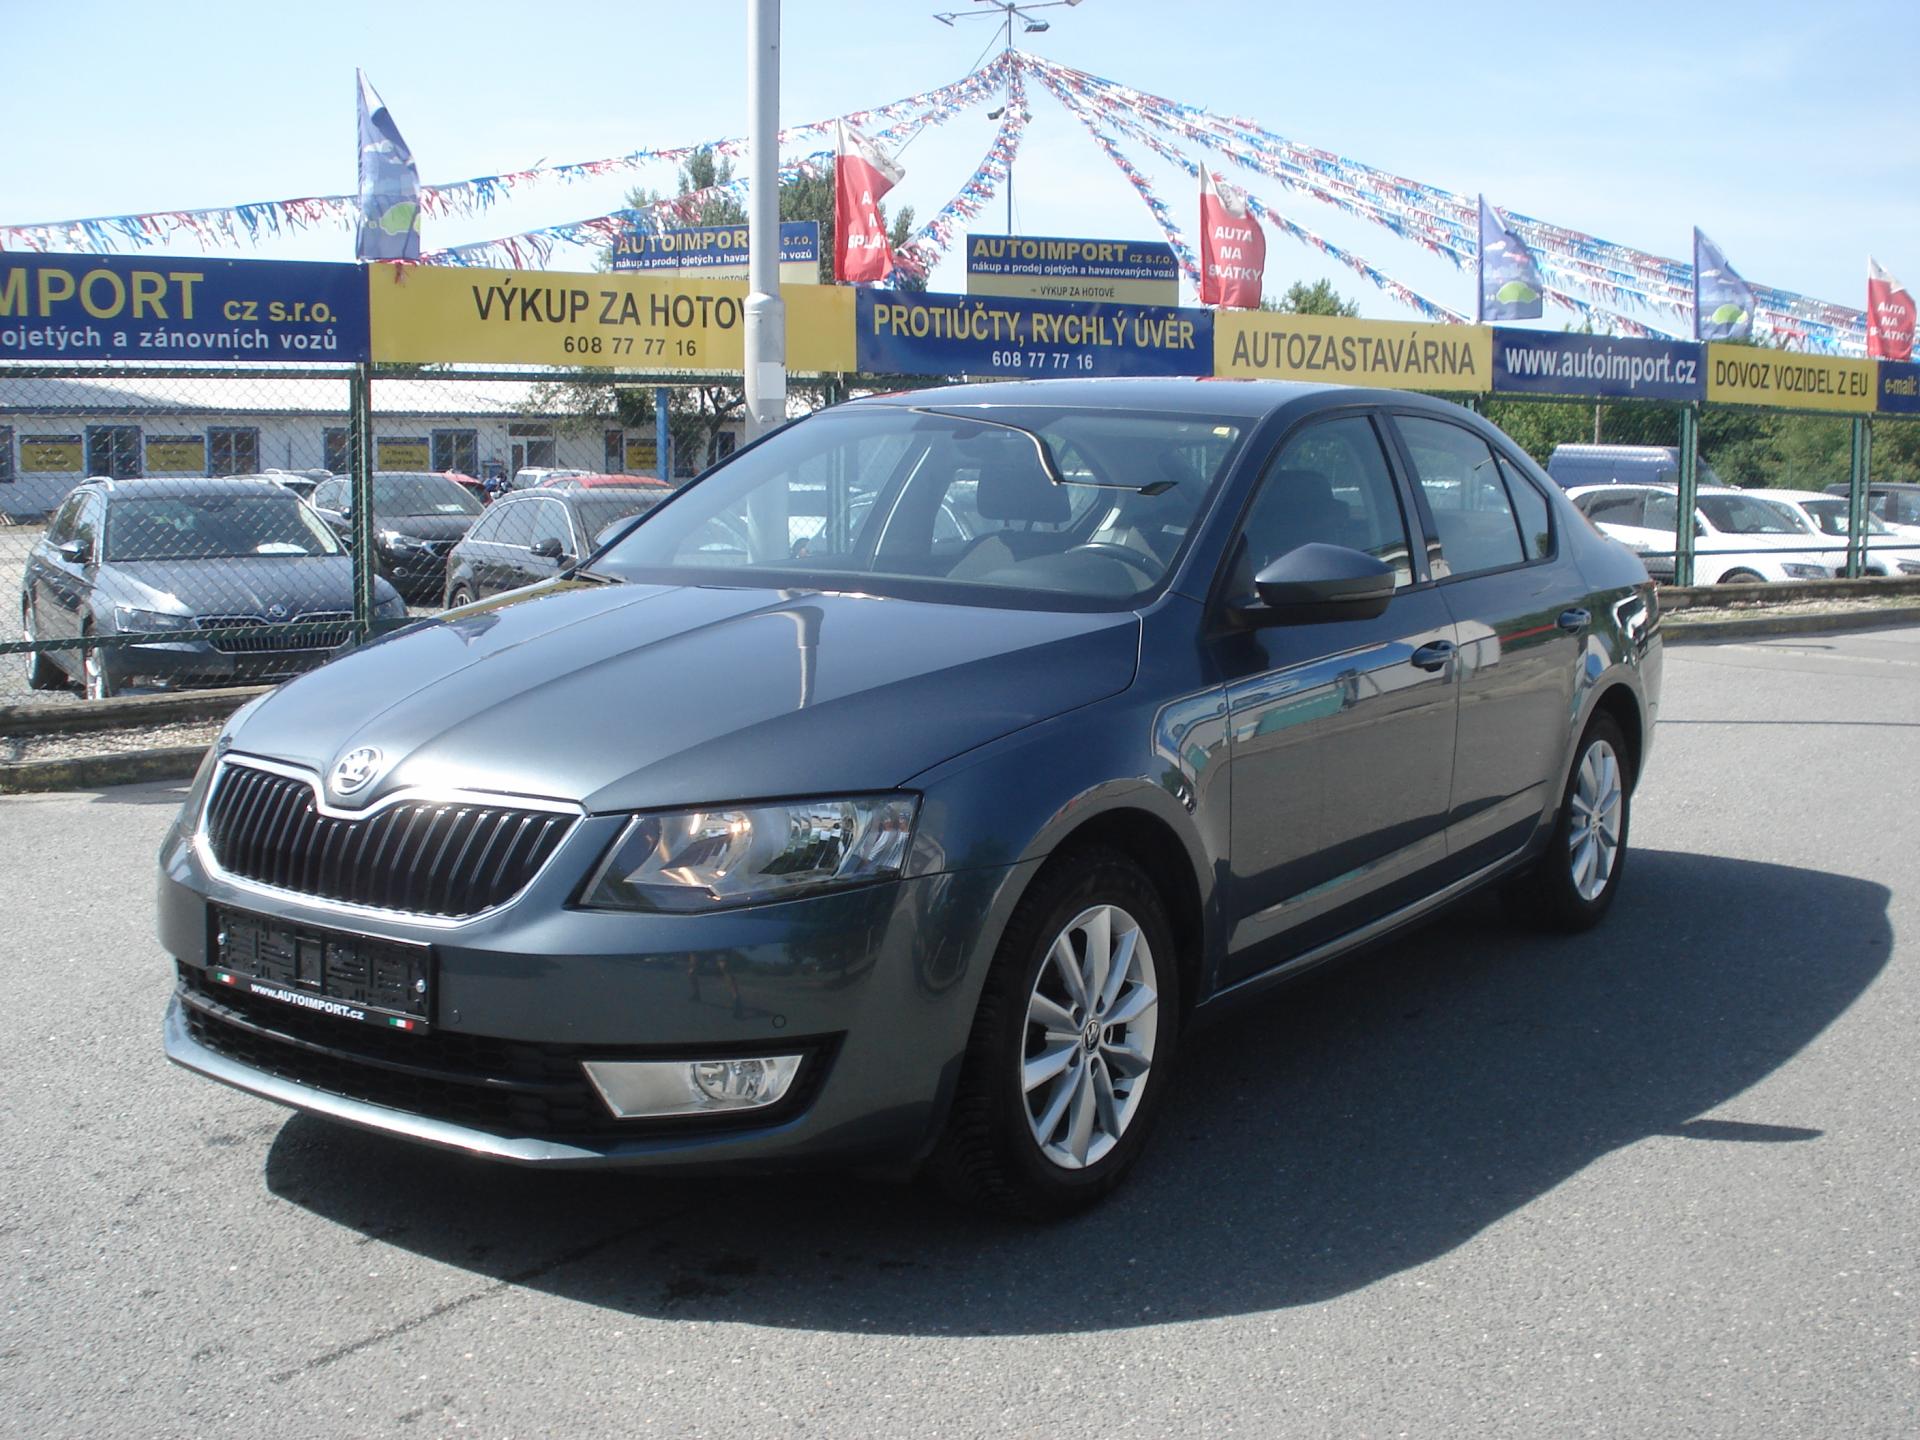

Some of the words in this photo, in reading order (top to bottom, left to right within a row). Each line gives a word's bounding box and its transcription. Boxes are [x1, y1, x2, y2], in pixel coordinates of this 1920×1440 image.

[617, 230, 750, 255] AUTOIMPOR
[1215, 226, 1253, 242] AUTA
[616, 256, 643, 268] nákup
[652, 256, 679, 267] prodej
[681, 254, 713, 266] ojetých
[715, 255, 721, 263] a
[973, 239, 1128, 263] AUTOIMPORT
[1220, 246, 1242, 260] NA
[972, 261, 1002, 273] nákup
[1003, 263, 1010, 271] a
[1012, 263, 1042, 275] prodej
[1044, 264, 1078, 275] ojetých
[1080, 266, 1086, 275] a
[1088, 265, 1152, 278] havarovaných
[472, 277, 590, 324] VÝKUP
[598, 290, 641, 326] ZA
[1069, 286, 1081, 297] ZA
[269, 301, 337, 323] s.r.o.
[873, 301, 1025, 348] PROTIÚČTY,
[1031, 310, 1128, 347] RYCHLÝ
[1134, 312, 1195, 350] ÚVĚR
[2, 324, 101, 351] ojetých
[113, 331, 127, 347] a
[139, 327, 269, 349] zánovních
[280, 328, 337, 350] vozů
[563, 335, 602, 354] 608
[612, 337, 634, 354] 77
[644, 338, 666, 355] 77
[676, 339, 697, 356] 16
[992, 351, 1021, 367] 608
[1028, 352, 1046, 368] 77
[1052, 353, 1070, 369] 77
[1077, 354, 1094, 370] 16
[1231, 330, 1475, 376] AUTOZASTAVÁRNA
[1505, 346, 1697, 389] www.autoimport.cz
[1716, 360, 1770, 389] DOVOZ
[1774, 365, 1834, 394] VOZIDEL
[1838, 371, 1846, 395] Z
[1850, 373, 1868, 397] EU
[1884, 375, 1918, 397] e-mail:
[250, 983, 365, 1020] www.AUTOIMPORT.cz
